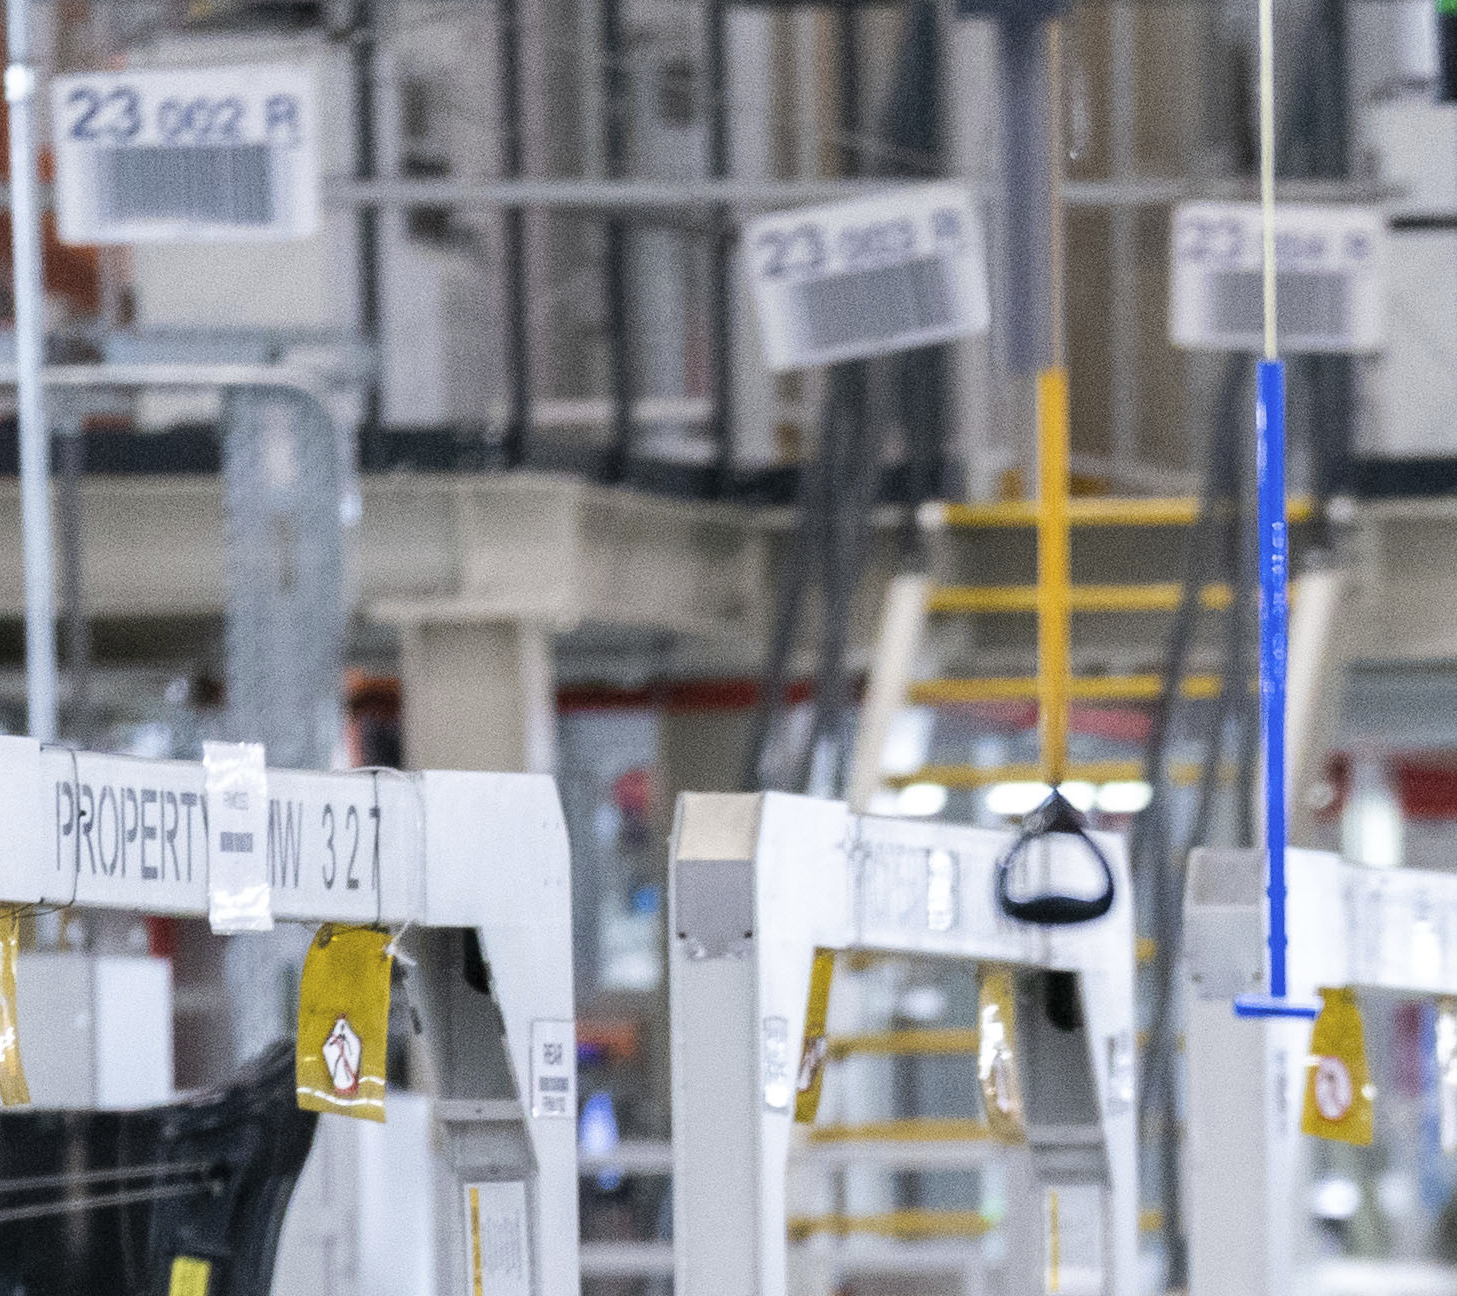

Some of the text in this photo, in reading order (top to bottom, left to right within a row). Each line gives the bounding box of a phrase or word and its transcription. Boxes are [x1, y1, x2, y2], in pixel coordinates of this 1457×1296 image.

[67, 86, 301, 148] 23 002 R
[756, 223, 827, 281] 23
